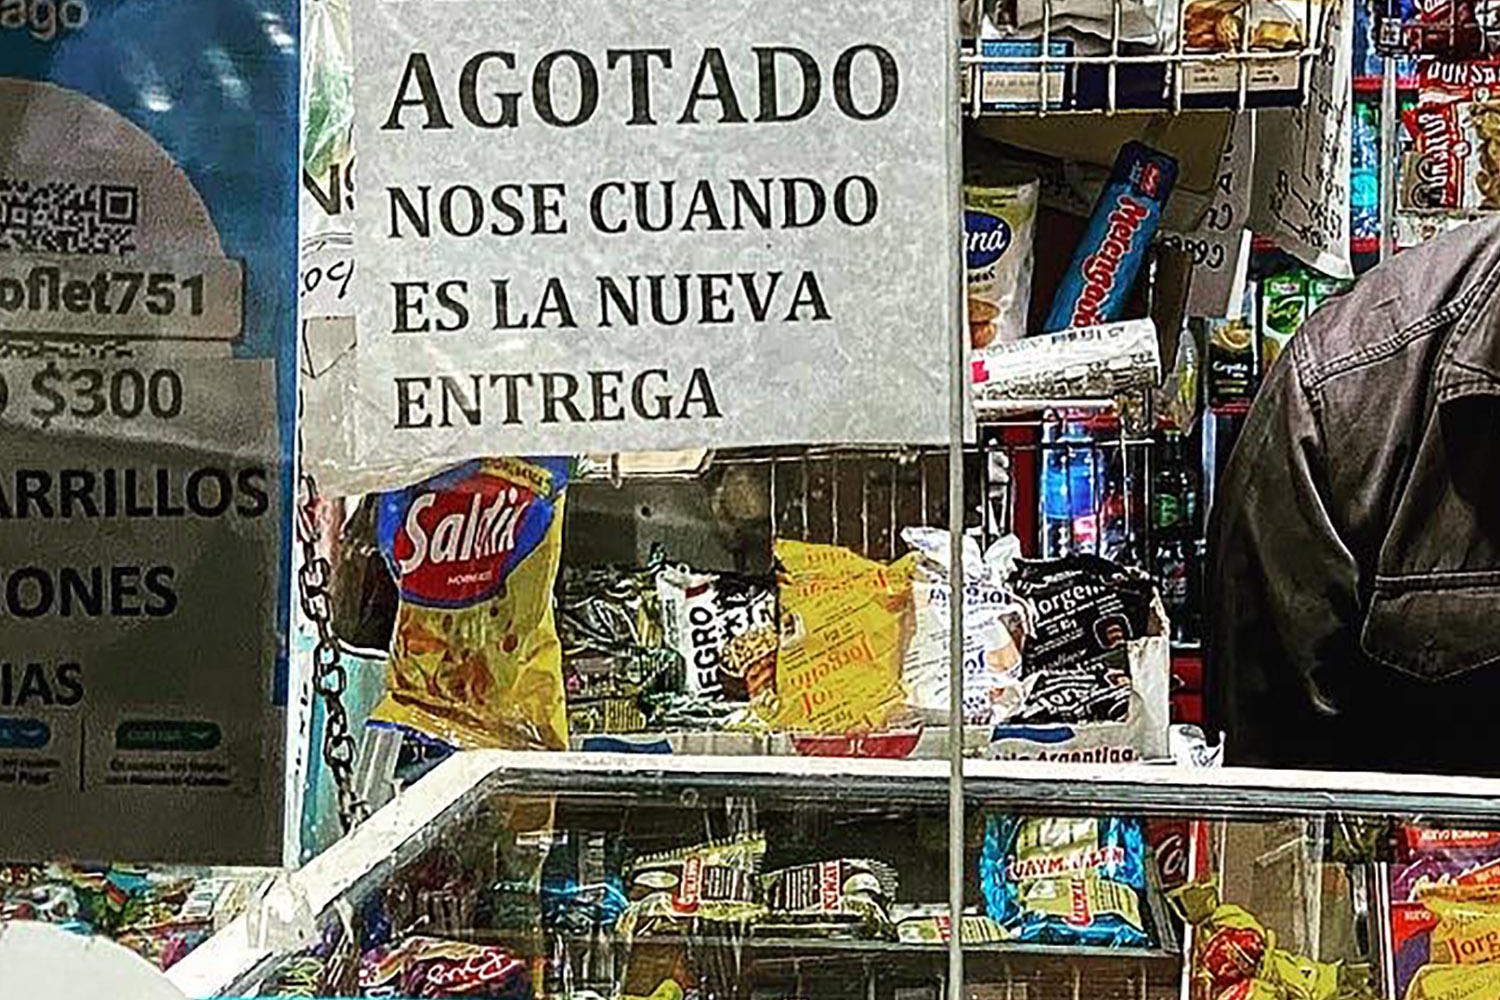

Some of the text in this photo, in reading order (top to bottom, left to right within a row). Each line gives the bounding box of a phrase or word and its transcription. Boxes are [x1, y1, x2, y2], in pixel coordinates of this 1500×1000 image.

[380, 44, 901, 131] AGOTADO
[386, 175, 879, 239] NOSE CUANDO
[390, 270, 833, 334] ES LA NUEVA
[30, 361, 183, 428] $300
[393, 367, 723, 430] ENTREGA
